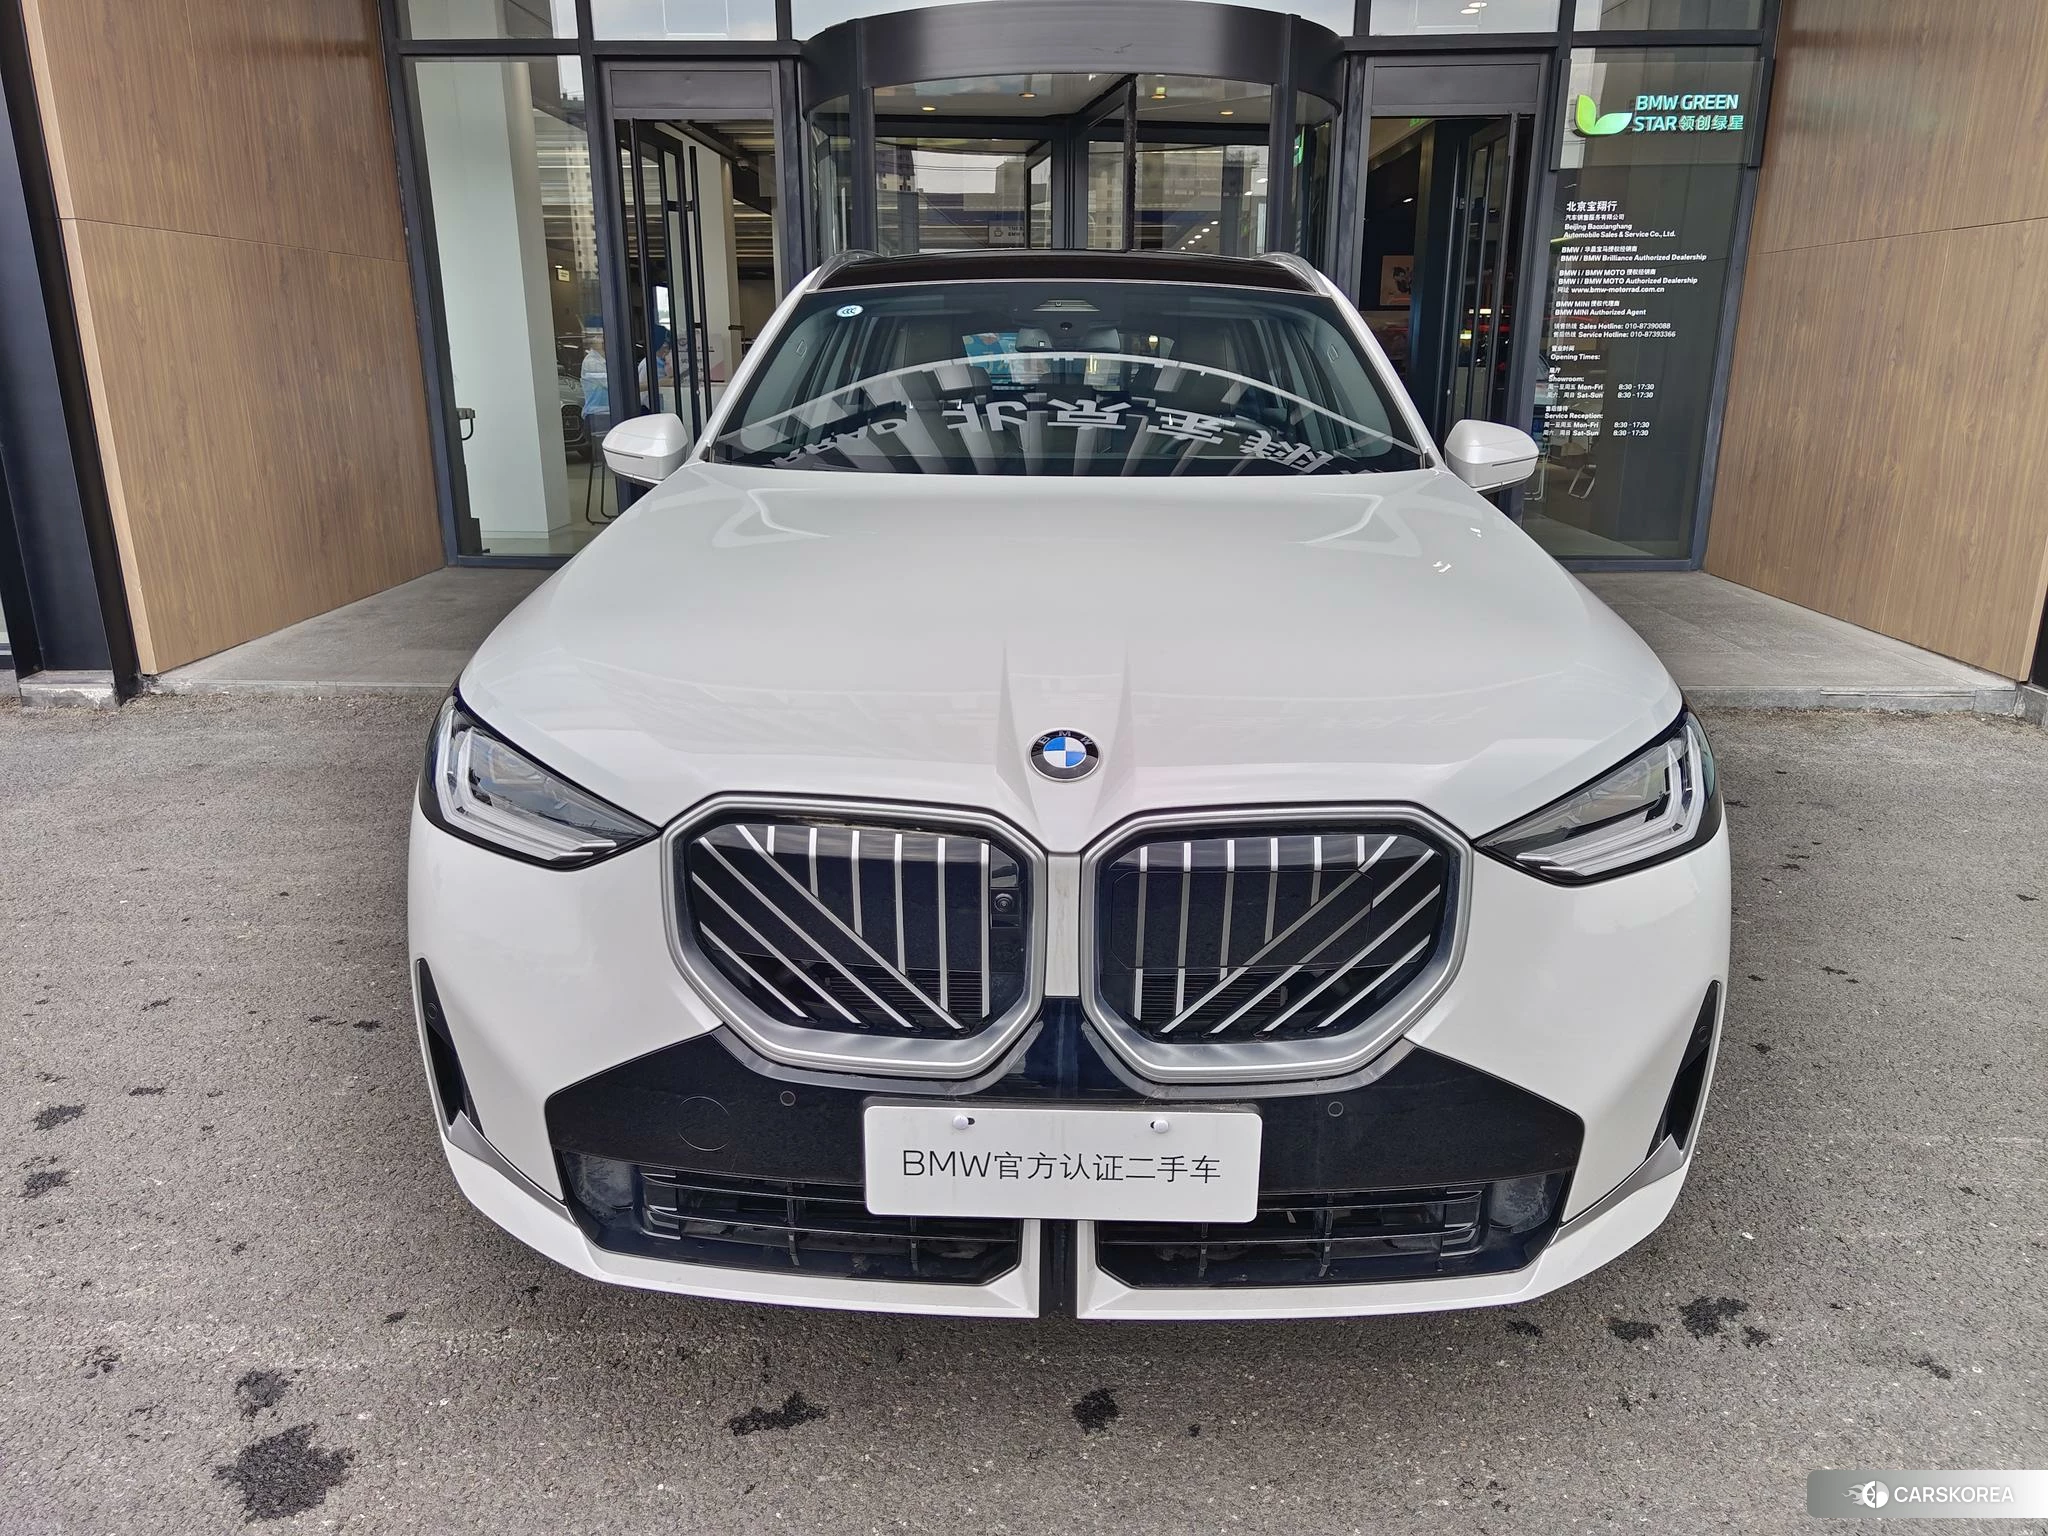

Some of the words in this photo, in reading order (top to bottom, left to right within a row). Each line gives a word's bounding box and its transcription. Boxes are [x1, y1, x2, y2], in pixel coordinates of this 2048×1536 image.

[1636, 94, 1679, 111] BMW
[1681, 94, 1739, 110] GREEN
[1632, 115, 1678, 132] STAR
[1679, 114, 1744, 131] 领创绿星
[1566, 200, 1618, 212] 北京宝翔行
[1564, 223, 1587, 231] Beijing
[1587, 223, 1633, 231] Baoxianghang
[1563, 231, 1600, 239] Automobile
[1583, 254, 1602, 262] BMW
[1634, 253, 1671, 261] Authorized
[1671, 253, 1707, 262] Dealership
[1559, 269, 1578, 277] BMW
[1585, 269, 1604, 277] BMW
[1603, 277, 1625, 285] MOTO
[1662, 276, 1698, 285] Dealership
[1555, 308, 1573, 316] BMW
[1573, 308, 1589, 316] MINI
[1589, 308, 1626, 316] Authorized
[1626, 308, 1647, 317] Agent
[1579, 322, 1597, 330] Sales
[1598, 322, 1624, 330] Hotline:
[1551, 353, 1578, 361] Opening
[1549, 374, 1585, 382] Showroom:
[1618, 383, 1632, 391] 8:30
[1577, 391, 1604, 399] Sat-Sun
[1617, 391, 1632, 399] 8:30
[1636, 391, 1654, 399] 17:30
[1569, 412, 1604, 420] Reception:
